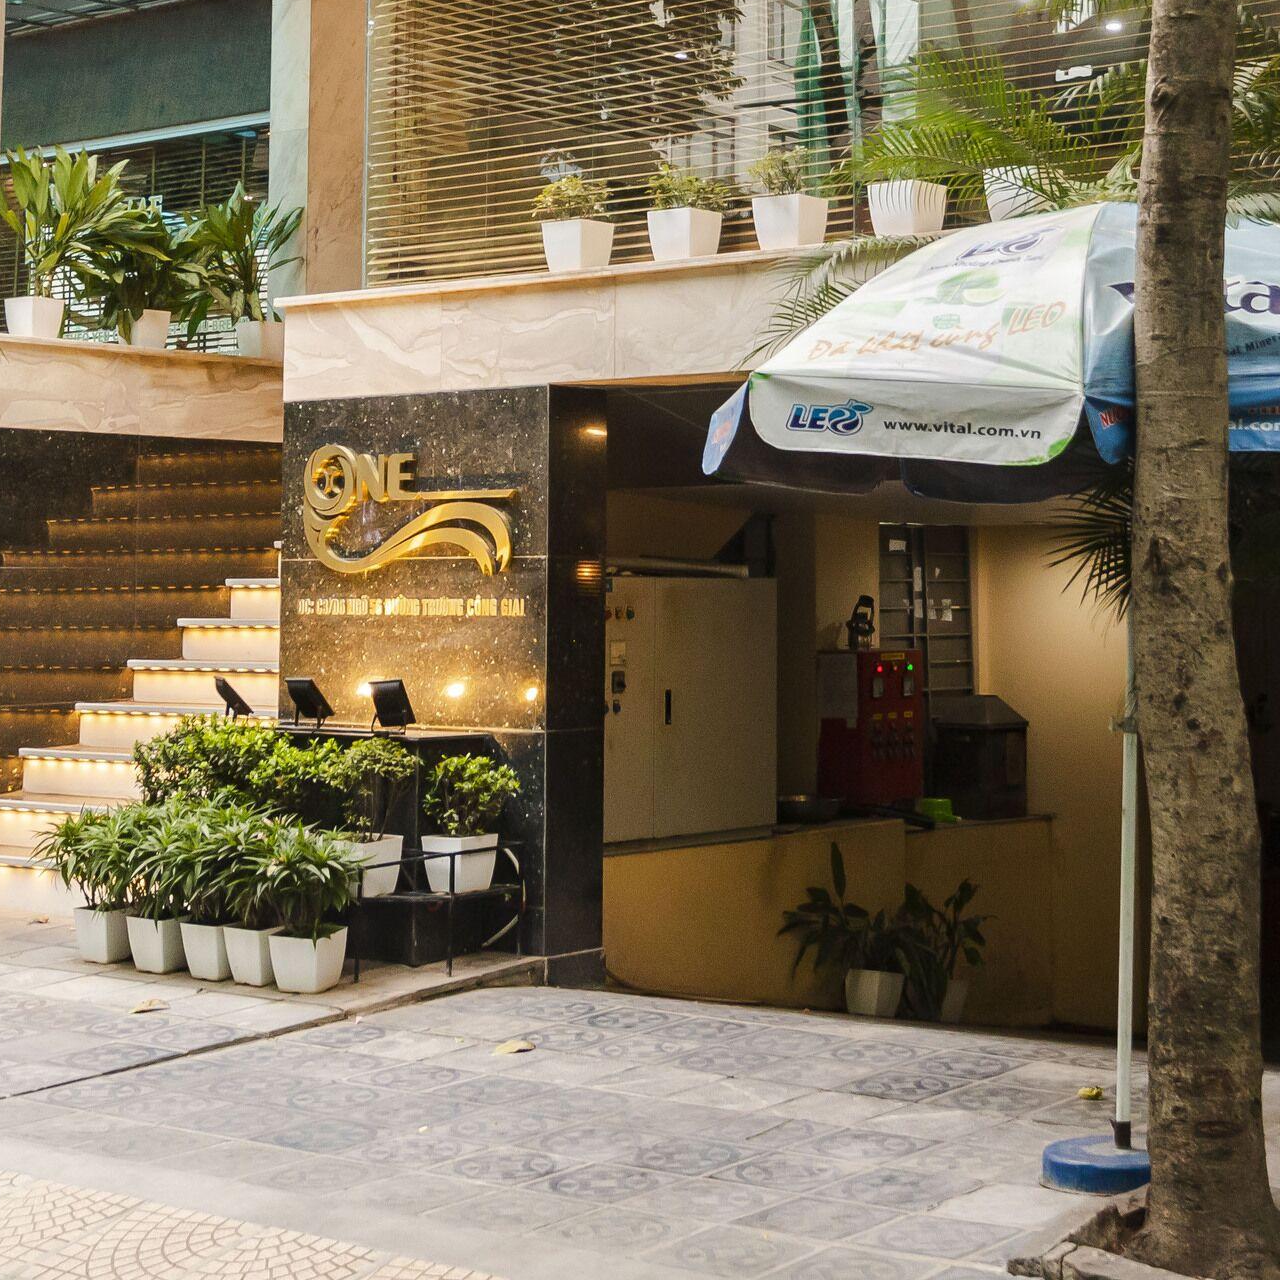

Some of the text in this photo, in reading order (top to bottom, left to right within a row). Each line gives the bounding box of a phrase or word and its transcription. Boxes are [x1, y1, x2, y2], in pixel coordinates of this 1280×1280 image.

[884, 420, 1041, 439] www.vital.com.vn
[304, 443, 417, 516] ONE
[466, 594, 497, 617] CÔNG
